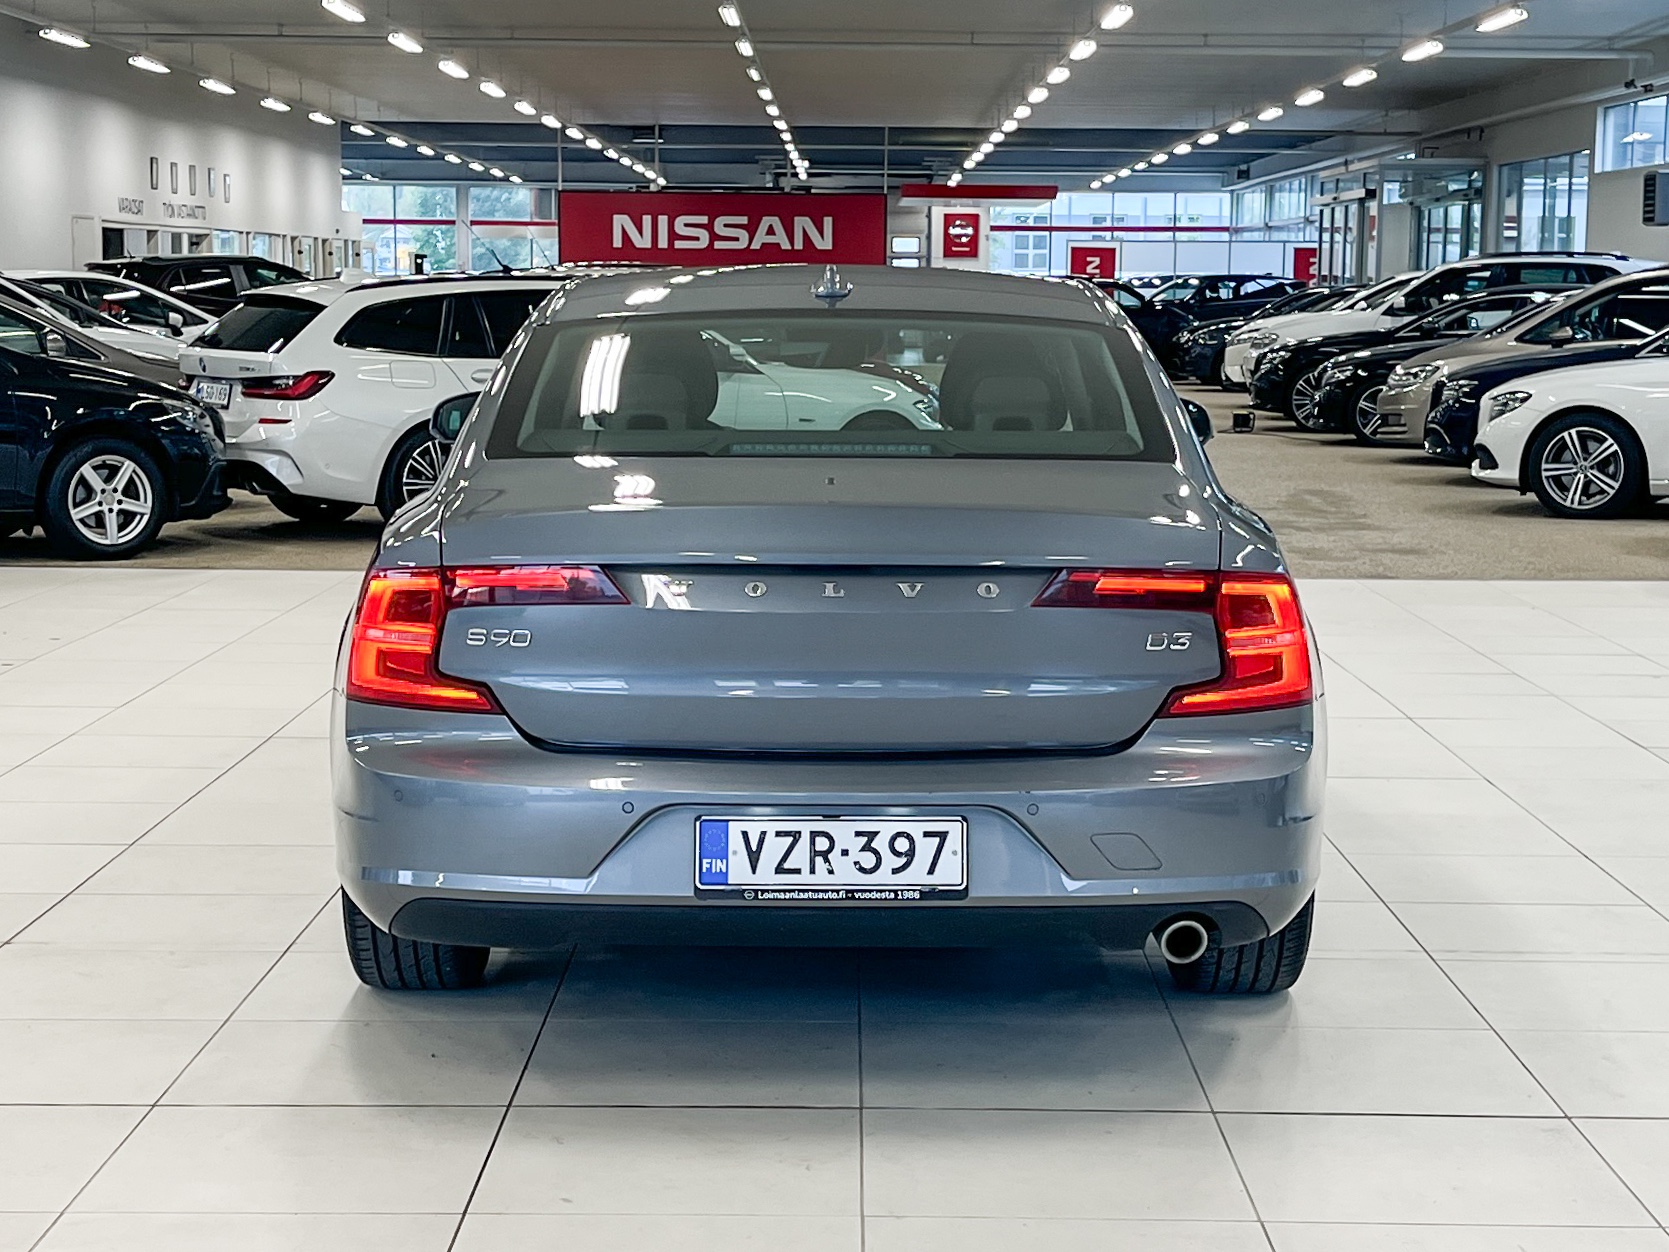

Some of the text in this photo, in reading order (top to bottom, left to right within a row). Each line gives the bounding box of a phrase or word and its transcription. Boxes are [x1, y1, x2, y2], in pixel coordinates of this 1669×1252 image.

[612, 214, 833, 250] NISSAN
[466, 627, 531, 647] S90
[1145, 632, 1193, 650] D3
[740, 830, 950, 876] VZR-397
[702, 858, 727, 873] FIN
[758, 890, 846, 900] Loimaanlaatuauto.fi
[854, 890, 895, 900] vuodesta
[897, 890, 921, 900] 1986
